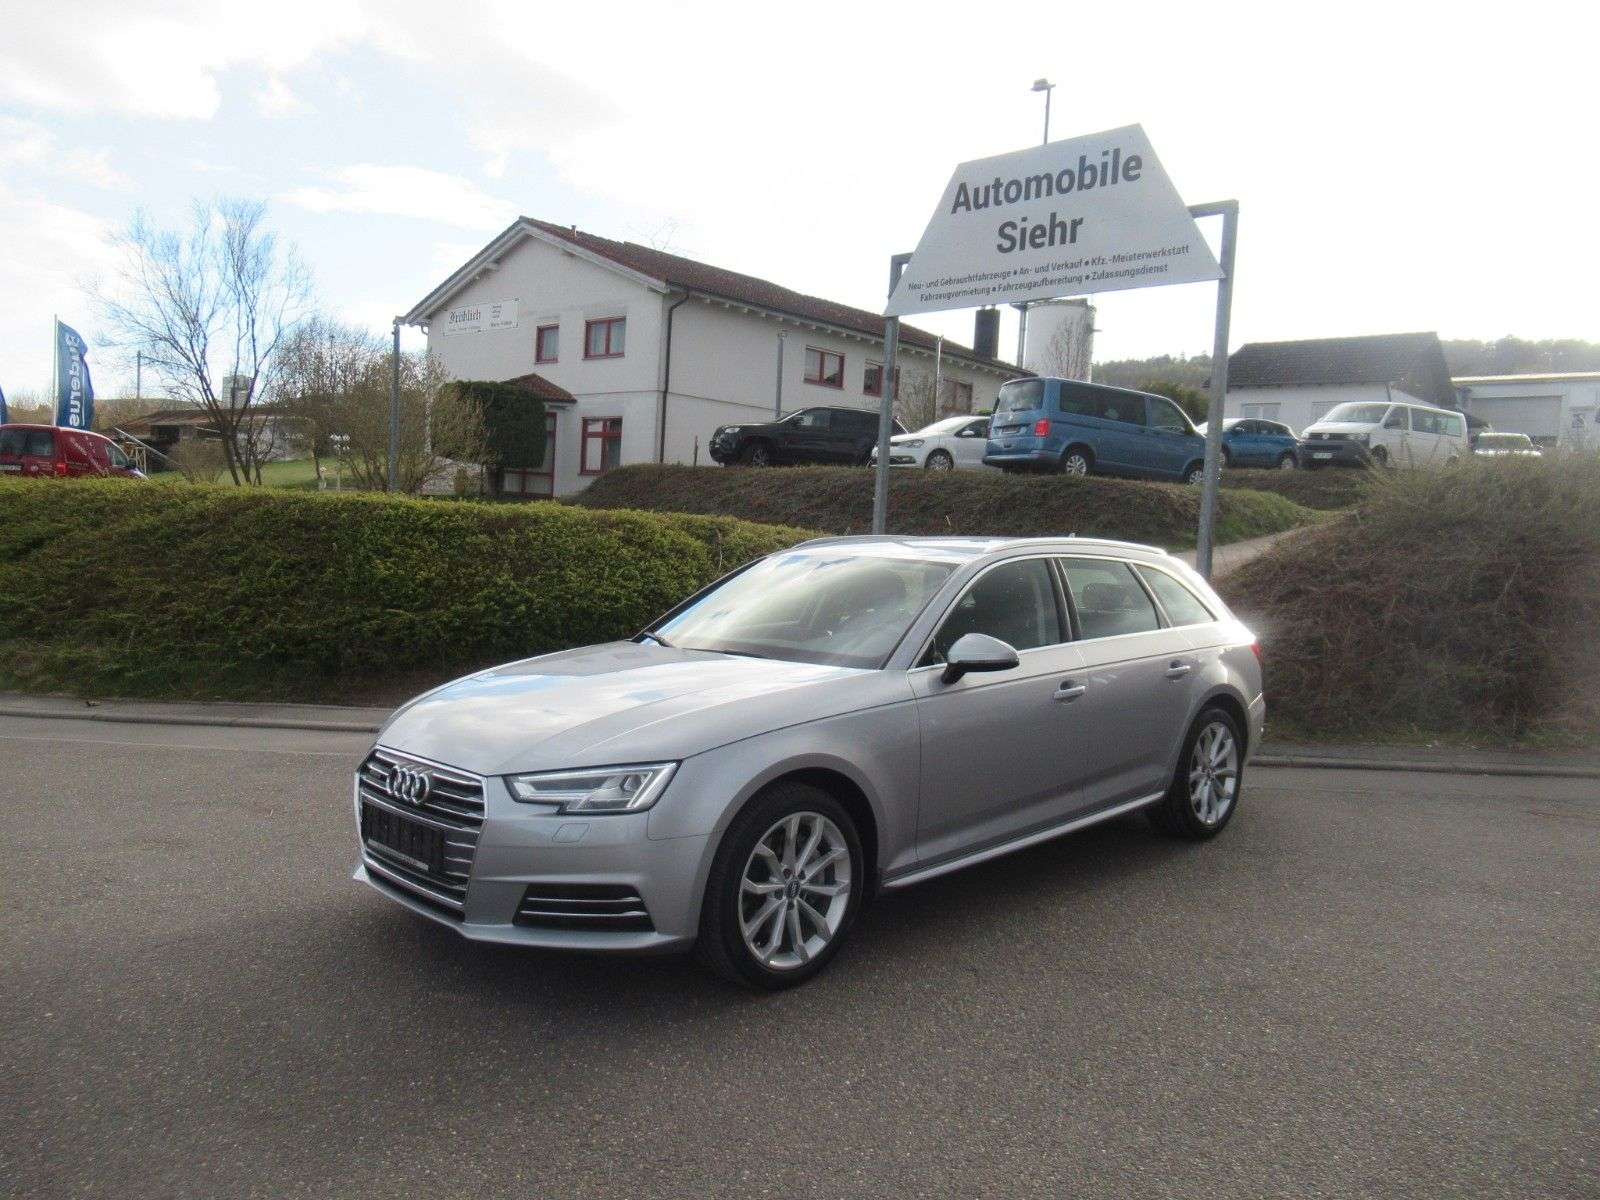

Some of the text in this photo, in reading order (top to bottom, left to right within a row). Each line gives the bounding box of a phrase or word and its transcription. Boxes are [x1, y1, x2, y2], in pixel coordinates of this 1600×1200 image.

[950, 148, 1143, 214] Automobile
[996, 212, 1084, 254] Siehr
[908, 283, 924, 291] Neu-
[926, 279, 939, 288] und
[940, 270, 1011, 287] Gebrauchtfahrzeuge
[1019, 267, 1033, 275] An-
[1035, 263, 1049, 273] und
[1052, 258, 1084, 272] Verkauf
[920, 263, 1168, 302] Fahrzeugvermietung Fahrzeugaufbereitung Zulassungsdienst
